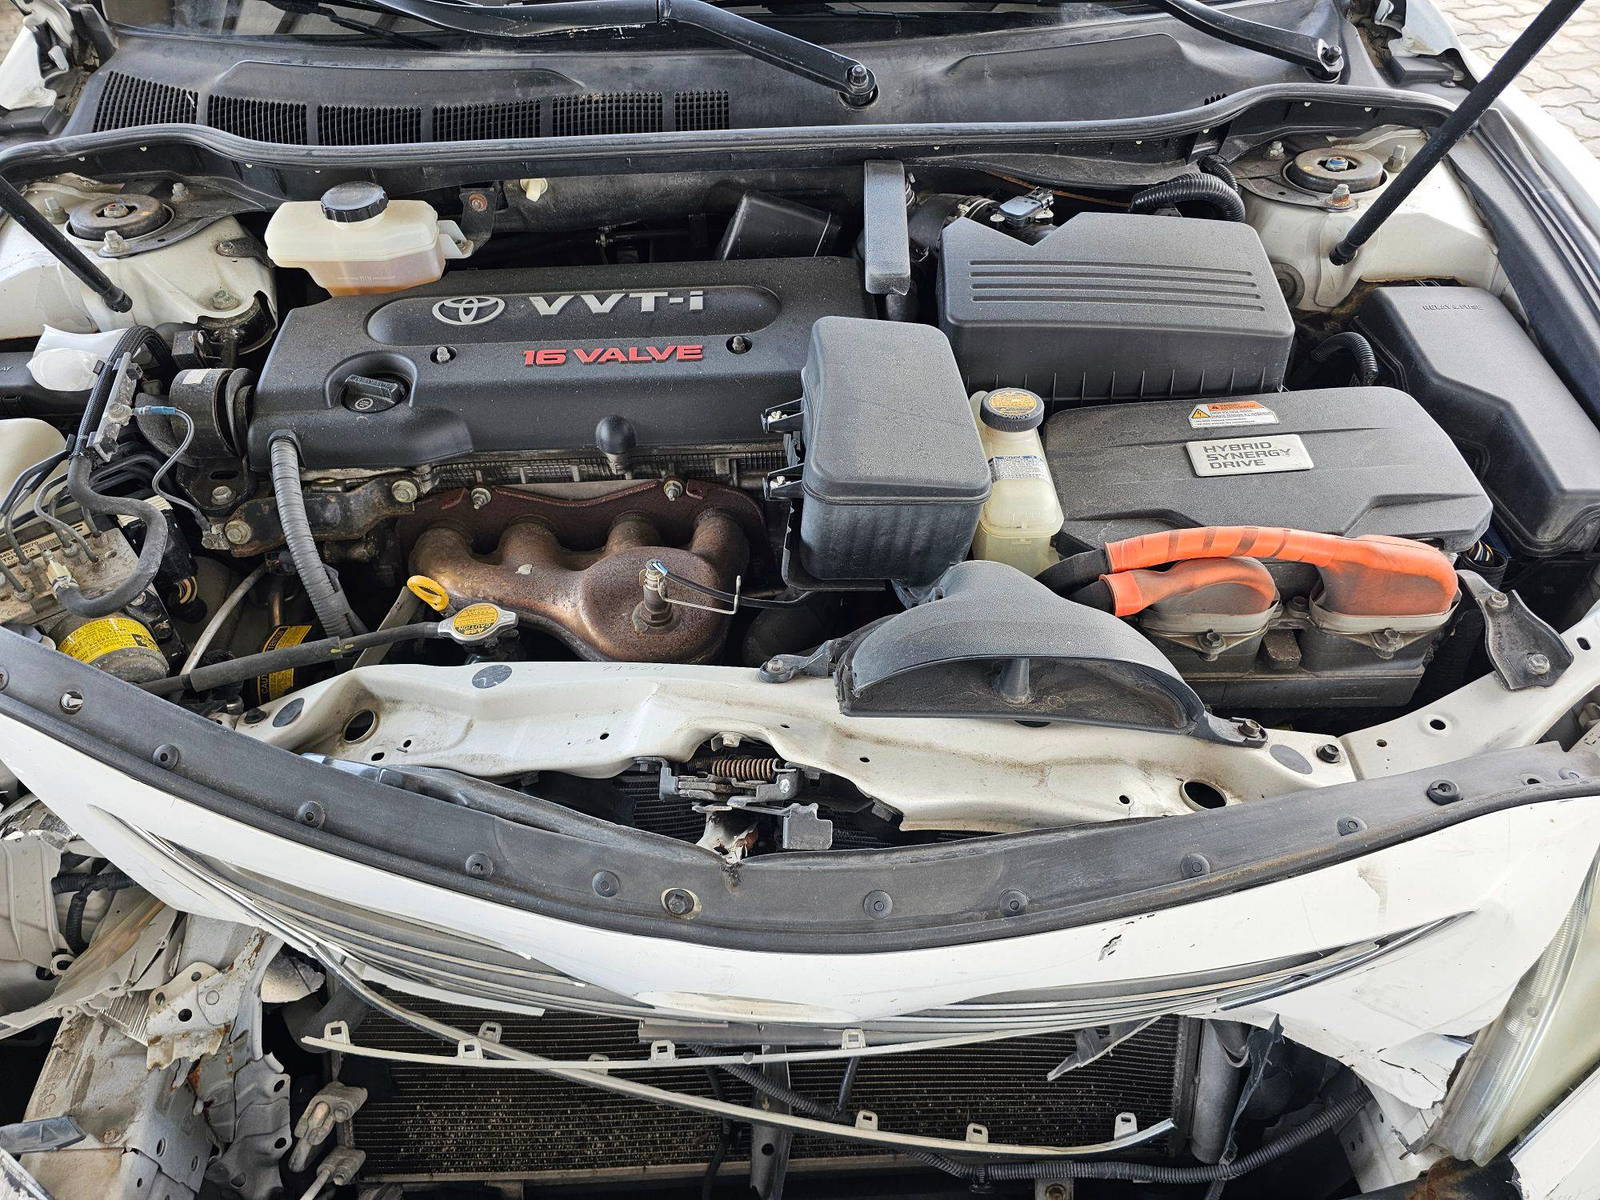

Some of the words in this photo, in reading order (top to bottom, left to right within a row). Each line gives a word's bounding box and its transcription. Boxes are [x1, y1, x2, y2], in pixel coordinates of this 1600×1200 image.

[528, 290, 703, 316] VVT-i
[522, 349, 567, 366] 16
[573, 344, 704, 365] VALVE
[1202, 441, 1272, 454] HYBRID
[1206, 448, 1291, 462] SYNERGY
[1209, 459, 1266, 470] DRIVE
